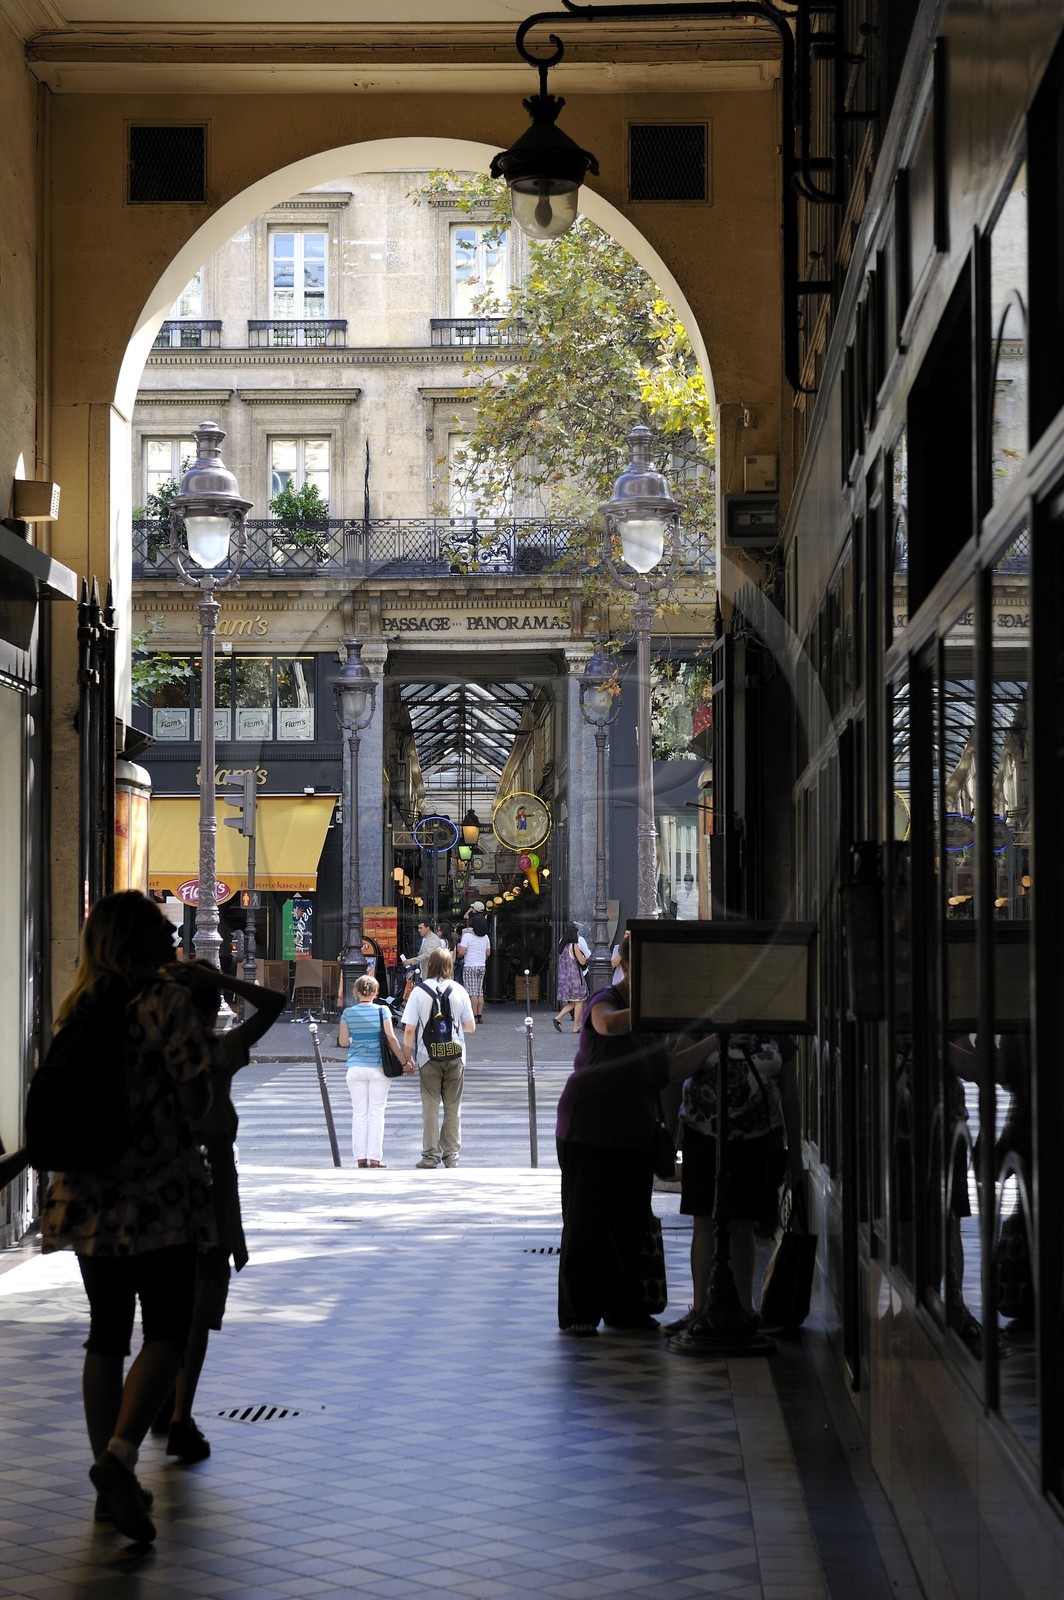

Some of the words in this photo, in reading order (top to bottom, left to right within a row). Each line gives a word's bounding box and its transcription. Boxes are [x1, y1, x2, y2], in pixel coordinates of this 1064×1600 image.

[381, 616, 450, 631] PASSAGE
[467, 616, 571, 631] PANORAMAS
[243, 719, 265, 728] Flam's
[285, 719, 306, 728] Flam's
[240, 880, 311, 889] flmmekueche
